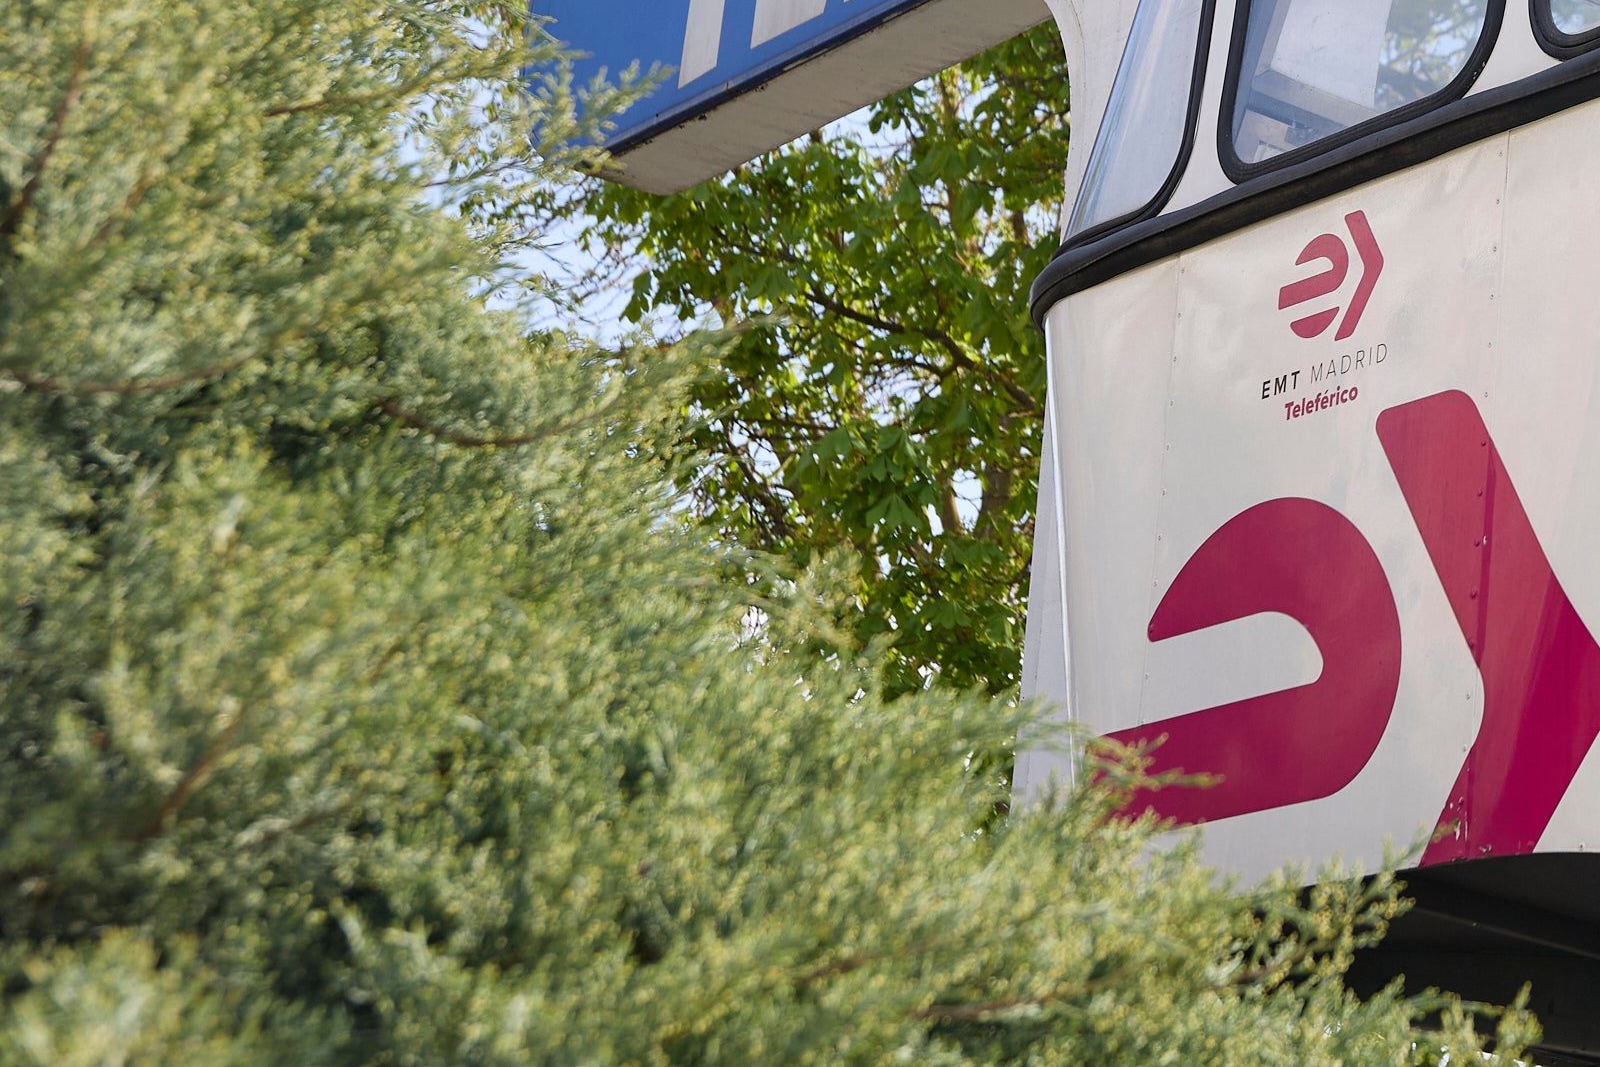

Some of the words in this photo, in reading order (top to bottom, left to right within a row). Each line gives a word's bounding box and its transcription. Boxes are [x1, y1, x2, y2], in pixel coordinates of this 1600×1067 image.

[1261, 370, 1301, 400] EMT
[1310, 343, 1388, 384] MADRID
[1285, 386, 1358, 421] Teleférico
